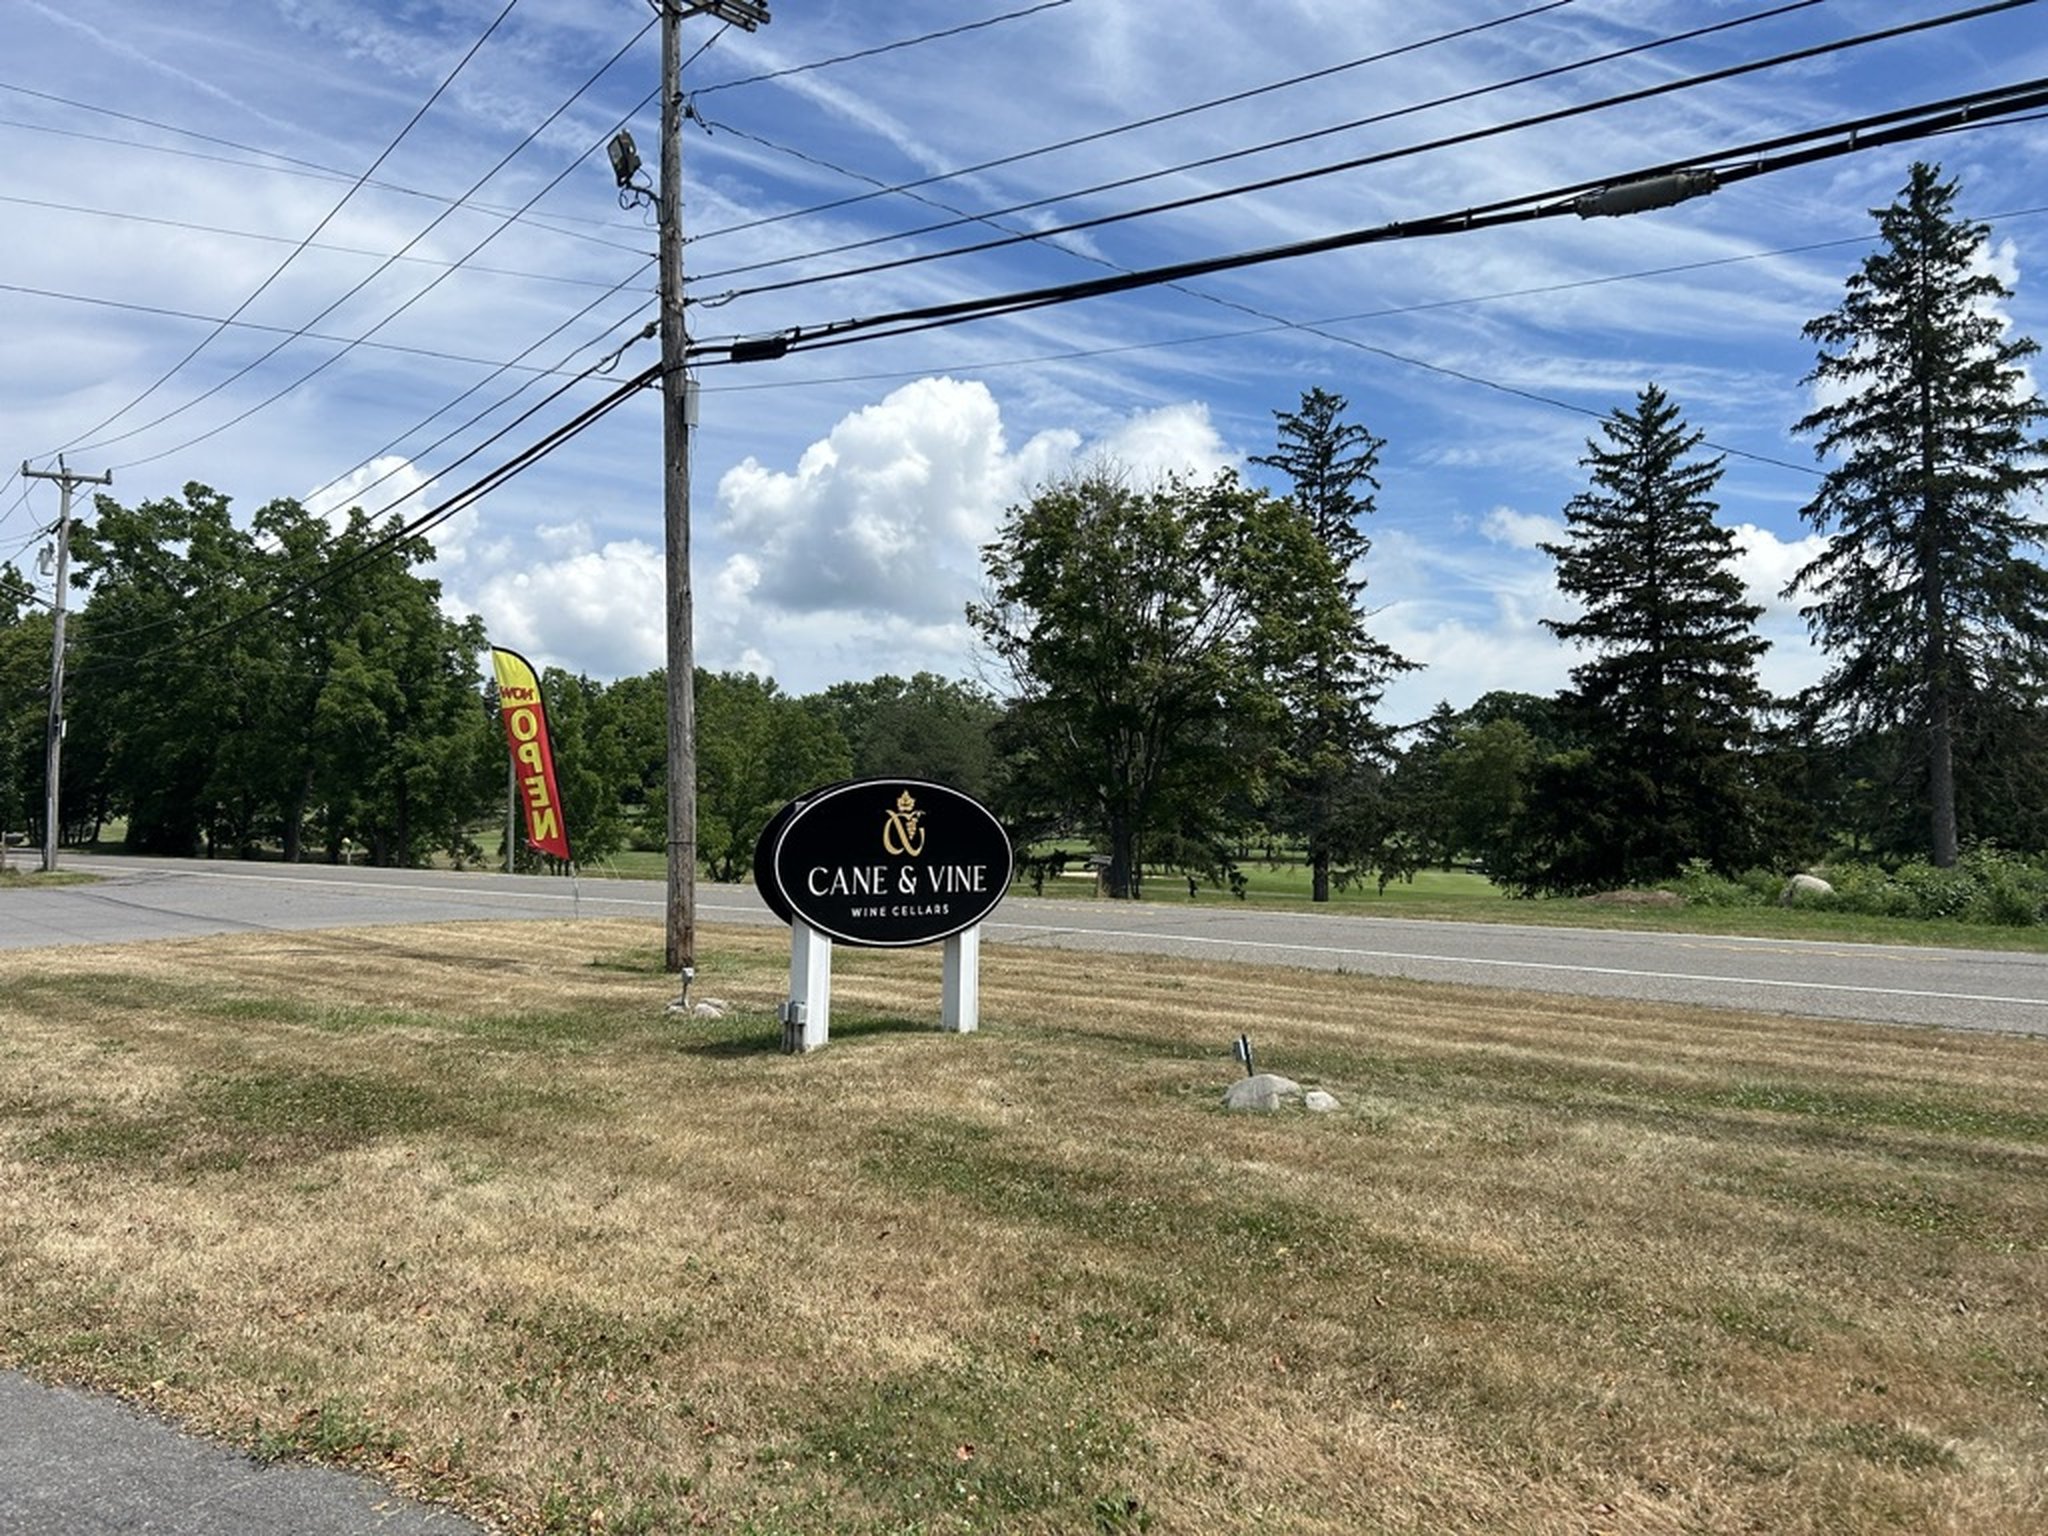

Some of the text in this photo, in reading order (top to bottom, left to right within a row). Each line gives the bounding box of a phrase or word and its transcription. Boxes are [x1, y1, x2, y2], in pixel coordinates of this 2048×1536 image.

[808, 865, 987, 896] CANE & VINE
[851, 904, 950, 918] WINE CELLARS
